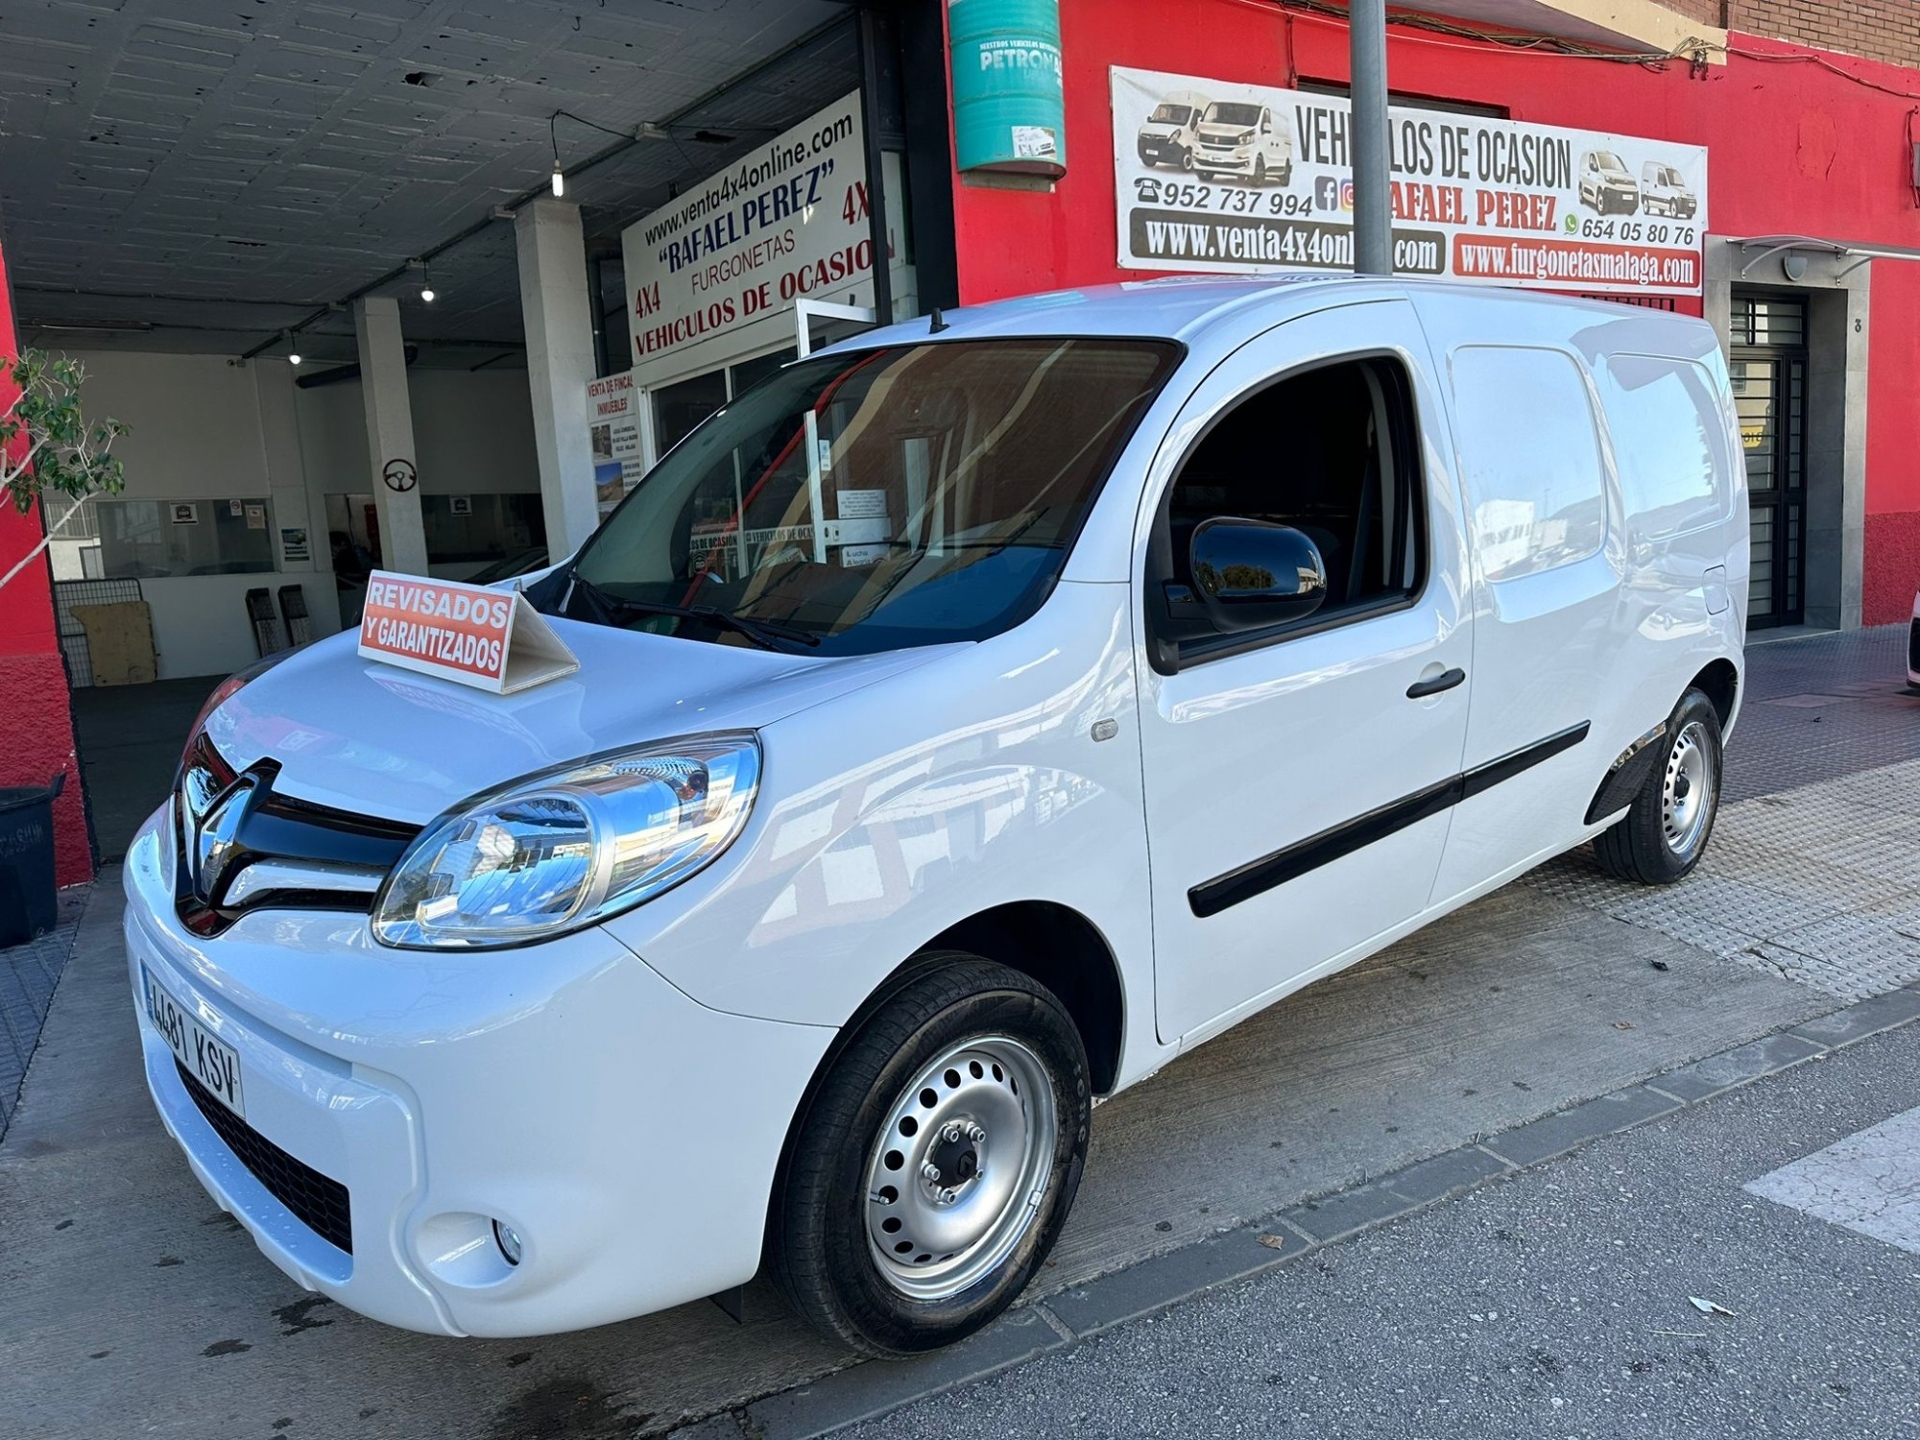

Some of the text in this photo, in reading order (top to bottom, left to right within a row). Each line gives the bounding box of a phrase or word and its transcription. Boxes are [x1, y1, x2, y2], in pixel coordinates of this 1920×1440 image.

[980, 48, 1062, 76] PETRONA
[1295, 105, 1571, 189] VEHILOS DE OCASION
[645, 114, 852, 246] www.venta4x4online.com
[1164, 183, 1313, 217] 952 737 994
[1390, 181, 1557, 231] AFAEL PEREZ
[1146, 221, 1437, 269] www.venta4x4onlcom
[1582, 219, 1694, 246] 654 05 80 76
[691, 229, 795, 295] FURGONETAS
[1461, 243, 1694, 285] www.furgonetasmalaga.com
[635, 281, 661, 318] 4X4
[635, 298, 735, 356] VEHICULOS
[743, 282, 773, 317] DE
[369, 582, 508, 629] REVISADOS
[366, 616, 501, 672] Y GARANTIZADOS
[152, 984, 234, 1103] 4481 KSV
